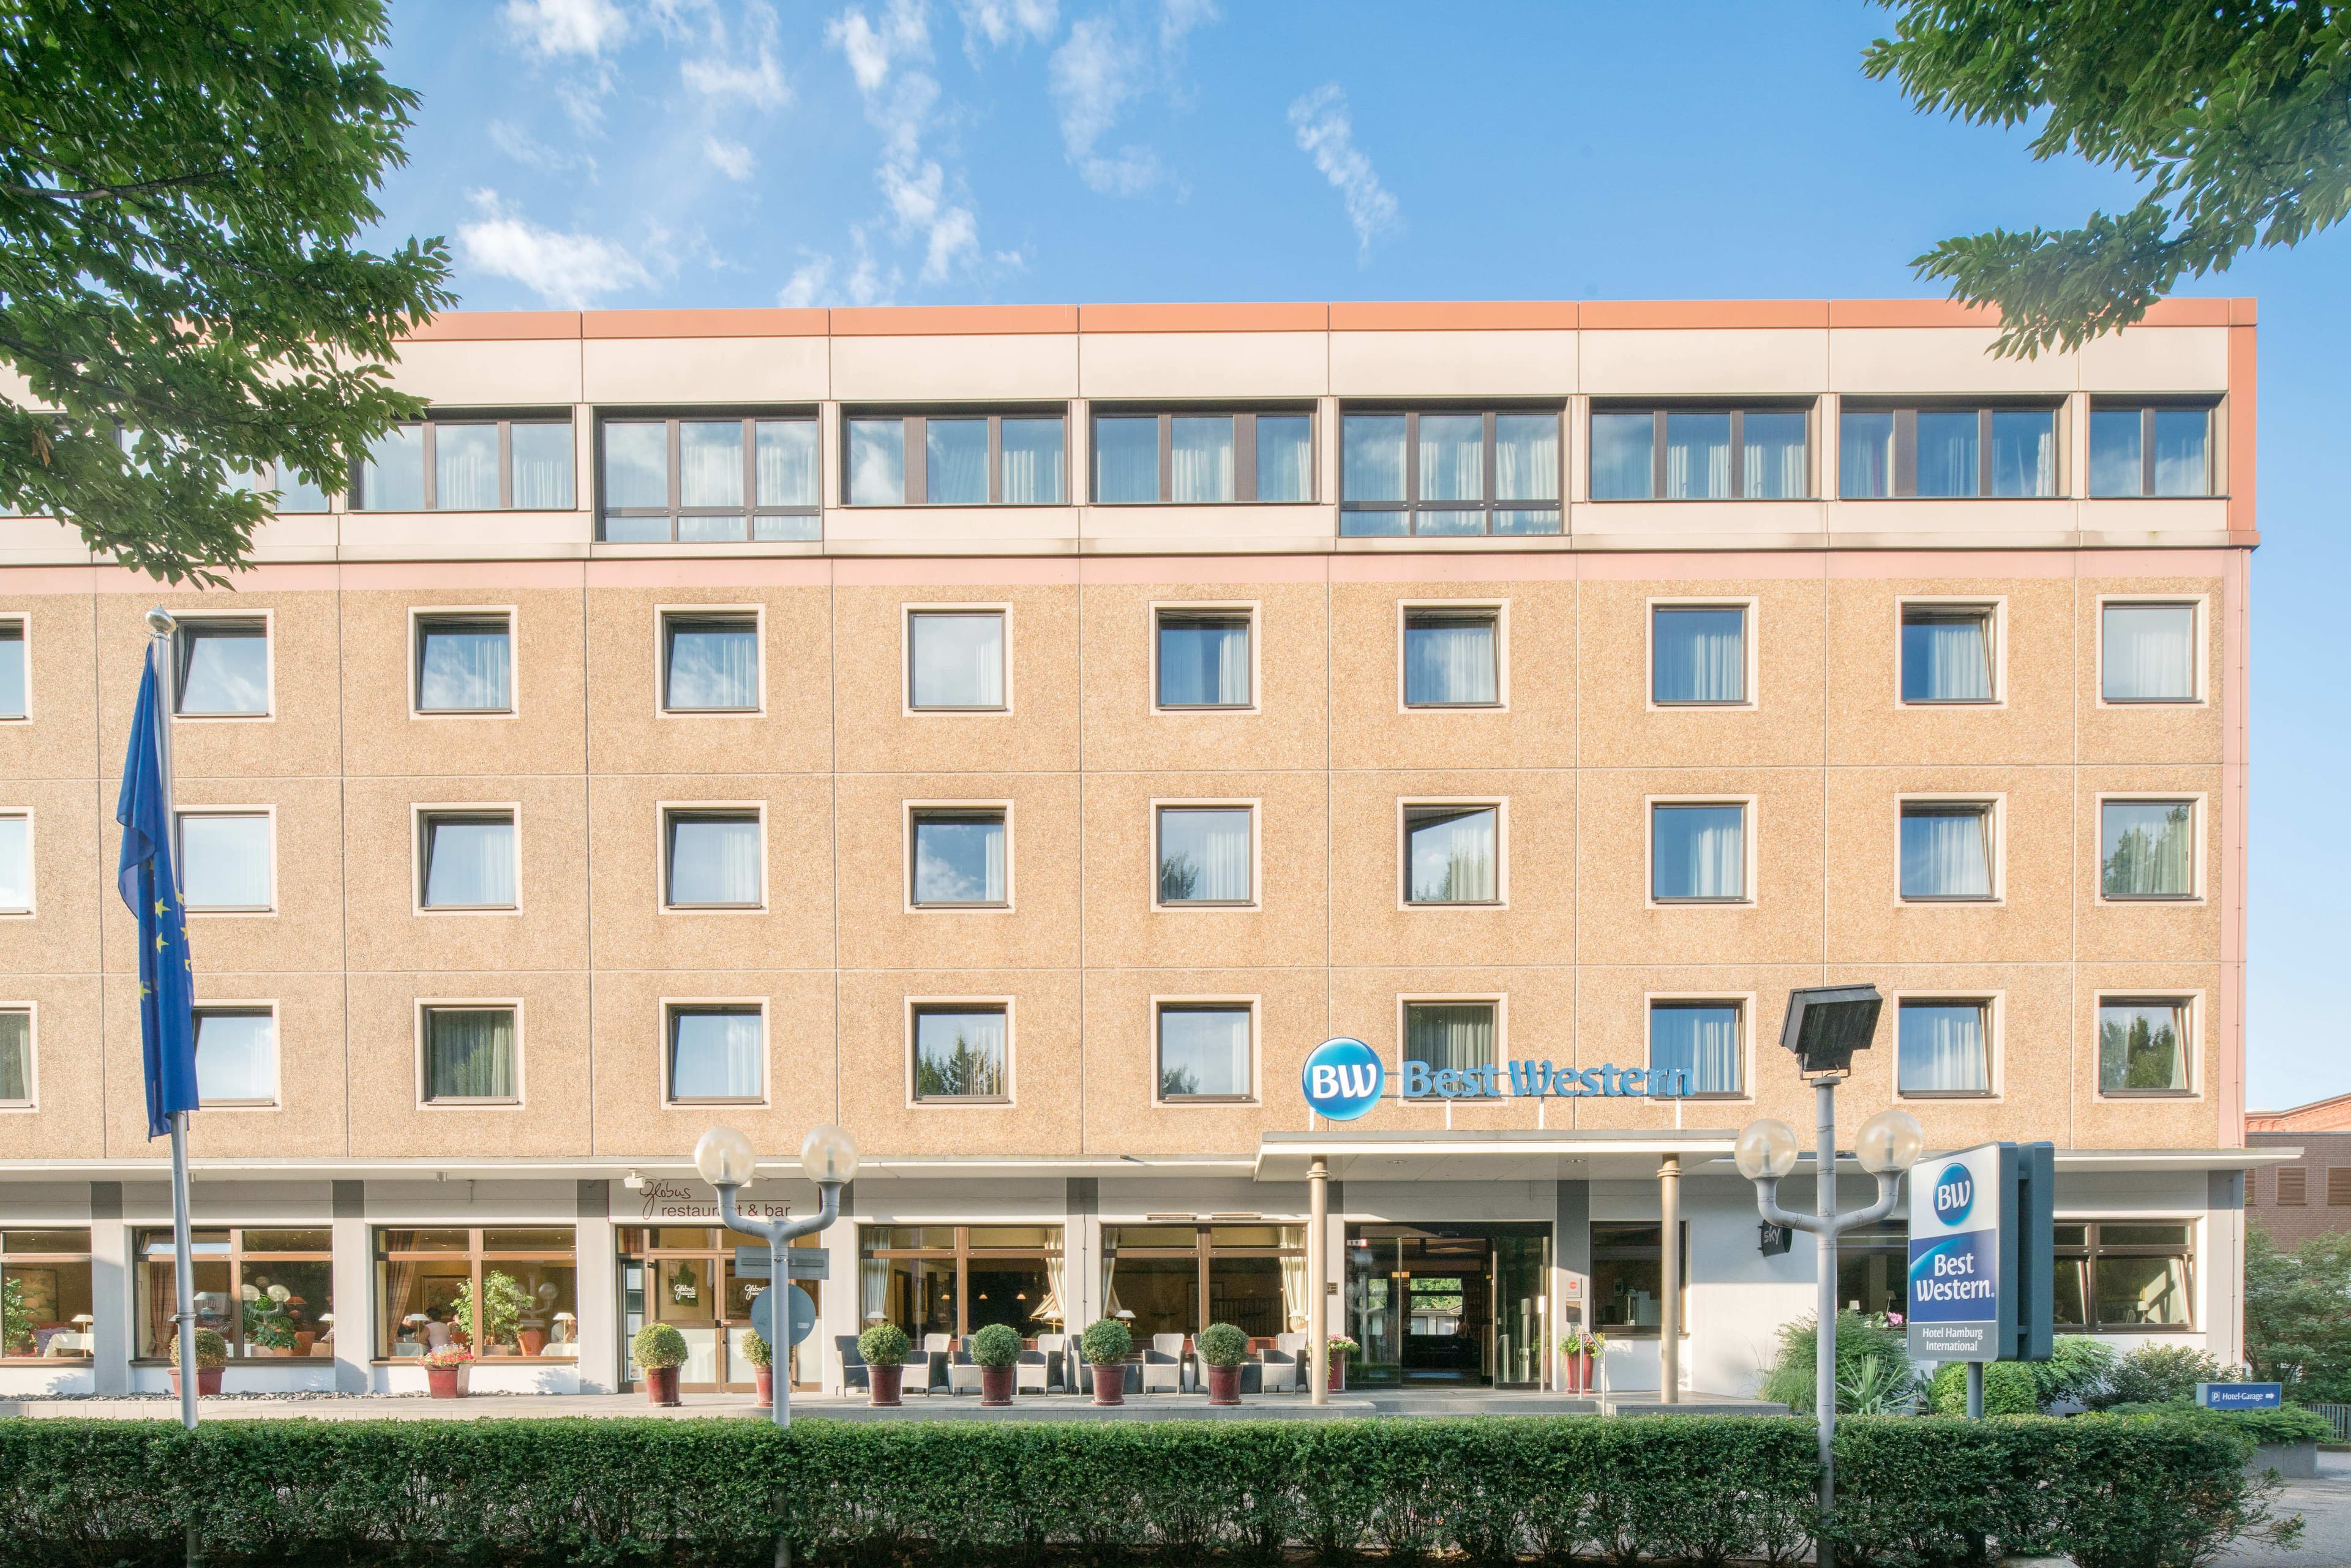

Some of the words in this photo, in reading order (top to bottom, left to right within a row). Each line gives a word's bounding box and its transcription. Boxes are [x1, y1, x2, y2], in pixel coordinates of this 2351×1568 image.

[1313, 1063, 1376, 1099] BW
[1403, 1060, 1501, 1097] Best
[1509, 1060, 1697, 1097] Western
[1938, 1180, 1970, 1210] BW
[661, 1204, 743, 1217] restaurt
[748, 1204, 758, 1217] &
[765, 1204, 791, 1217] bar
[1764, 1225, 1780, 1245] sky
[1935, 1253, 1974, 1277] Best
[1922, 1327, 1943, 1338] Hotel
[1946, 1327, 1983, 1340] Hamburg
[1926, 1341, 1978, 1351] International
[2222, 1392, 2263, 1401] Hotel-Garage
